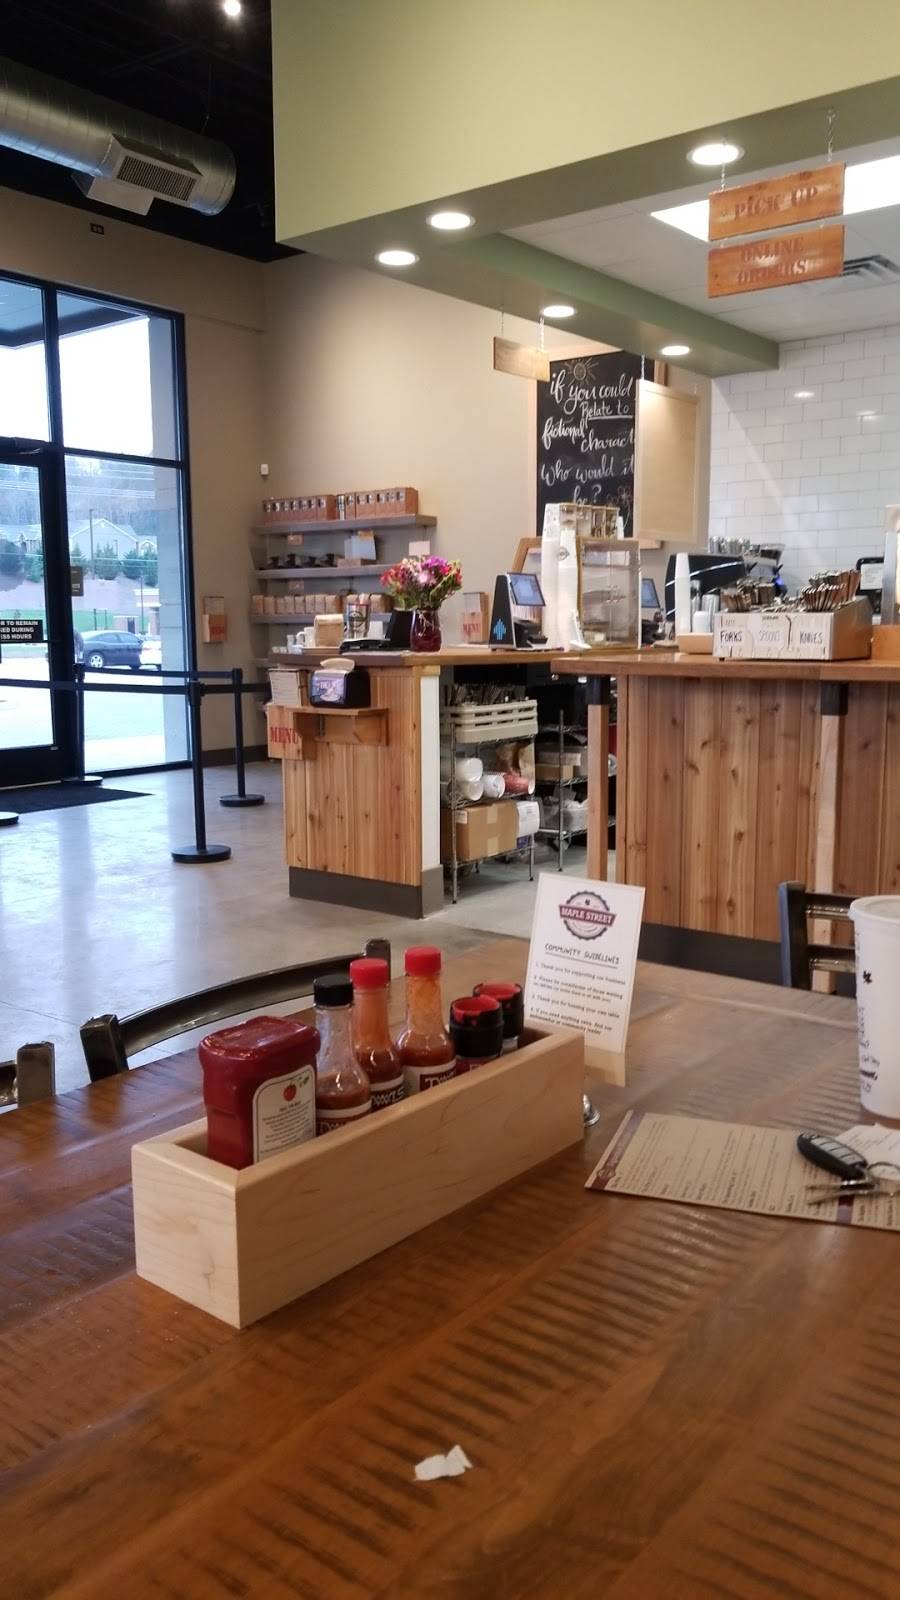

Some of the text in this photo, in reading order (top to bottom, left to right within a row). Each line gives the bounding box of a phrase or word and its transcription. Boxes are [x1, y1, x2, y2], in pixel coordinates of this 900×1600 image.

[550, 369, 634, 415] if you could
[580, 400, 630, 429] Relate to
[542, 416, 585, 450] fictional
[575, 454, 614, 483] would
[720, 631, 743, 643] FORKS
[800, 632, 823, 645] KNIVES
[270, 727, 299, 745] MENU
[561, 907, 613, 924] MAPLE STREET
[545, 943, 620, 965] COMMUNITY GUIDELINES
